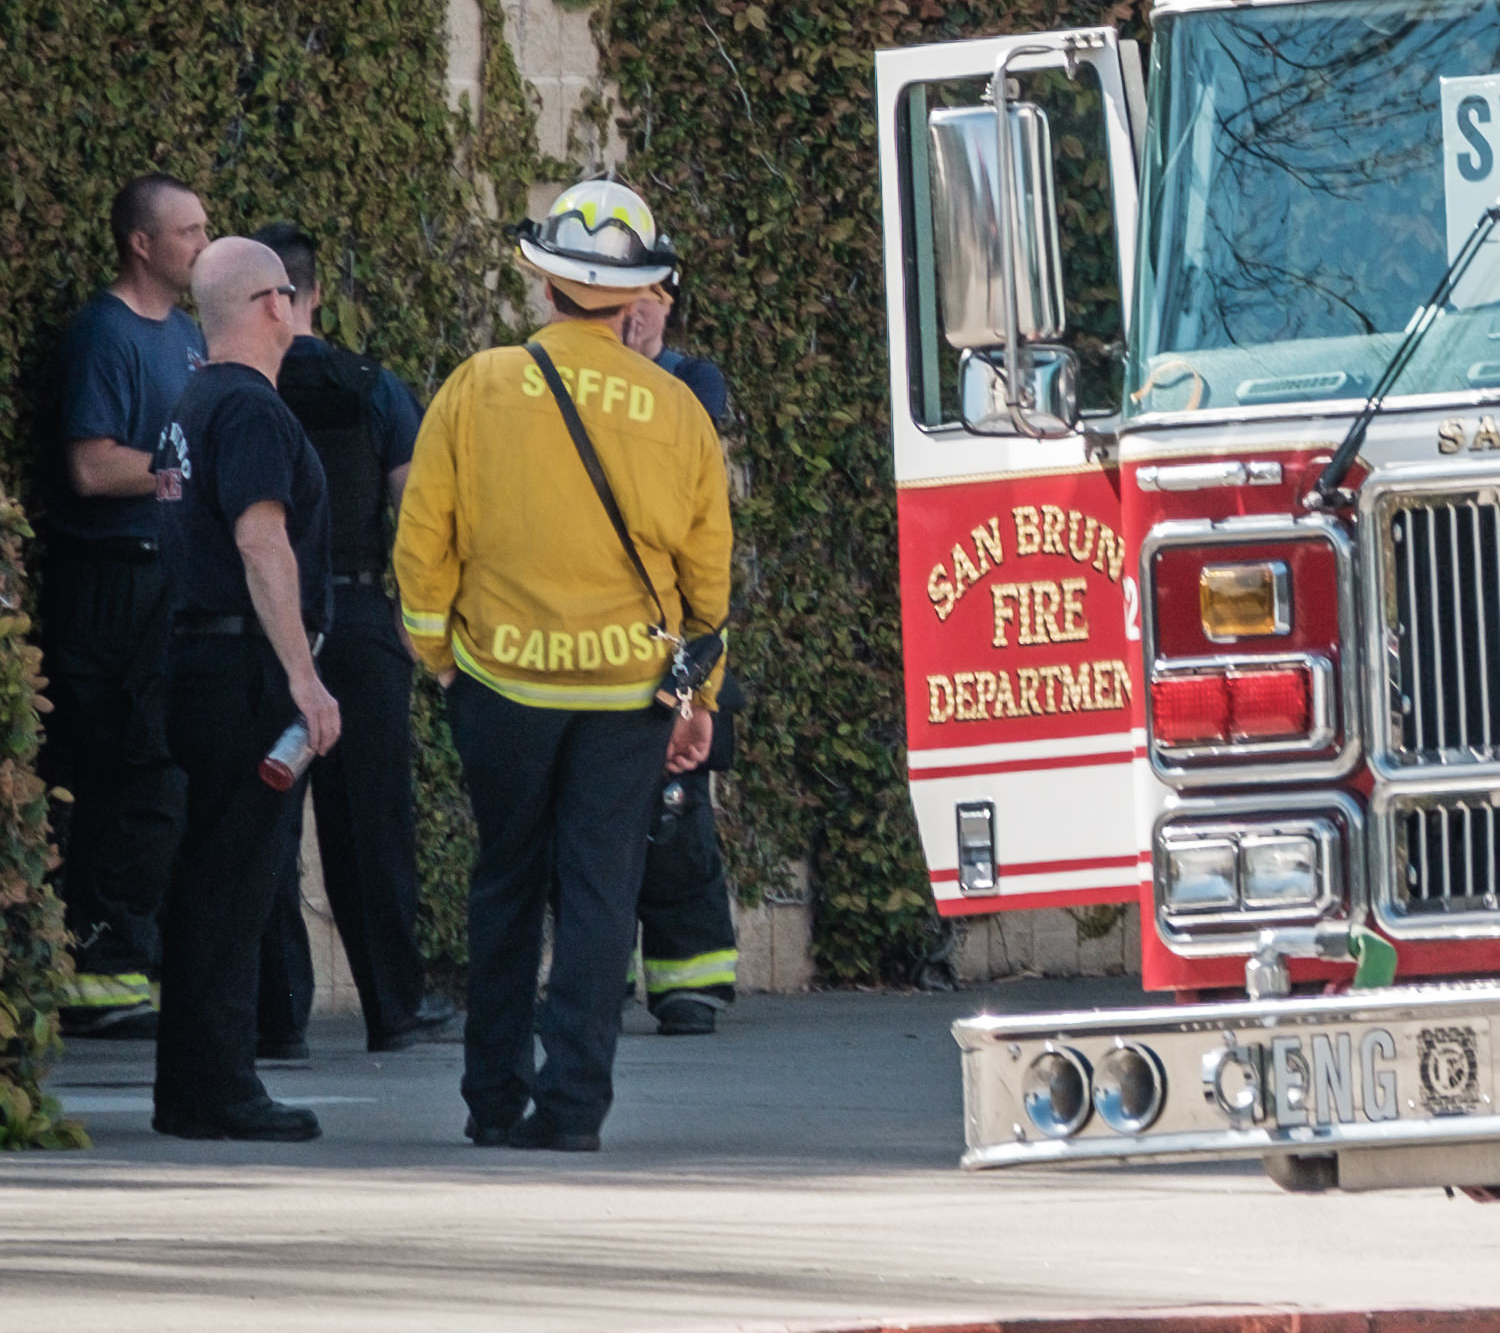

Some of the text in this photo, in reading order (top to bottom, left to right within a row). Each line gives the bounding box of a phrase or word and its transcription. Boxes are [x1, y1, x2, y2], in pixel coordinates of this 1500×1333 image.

[927, 504, 1127, 622] SAN BRUN
[990, 576, 1090, 649] FIRE
[926, 658, 1133, 725] DEPARTMEN
[1271, 1027, 1399, 1129] ENG
